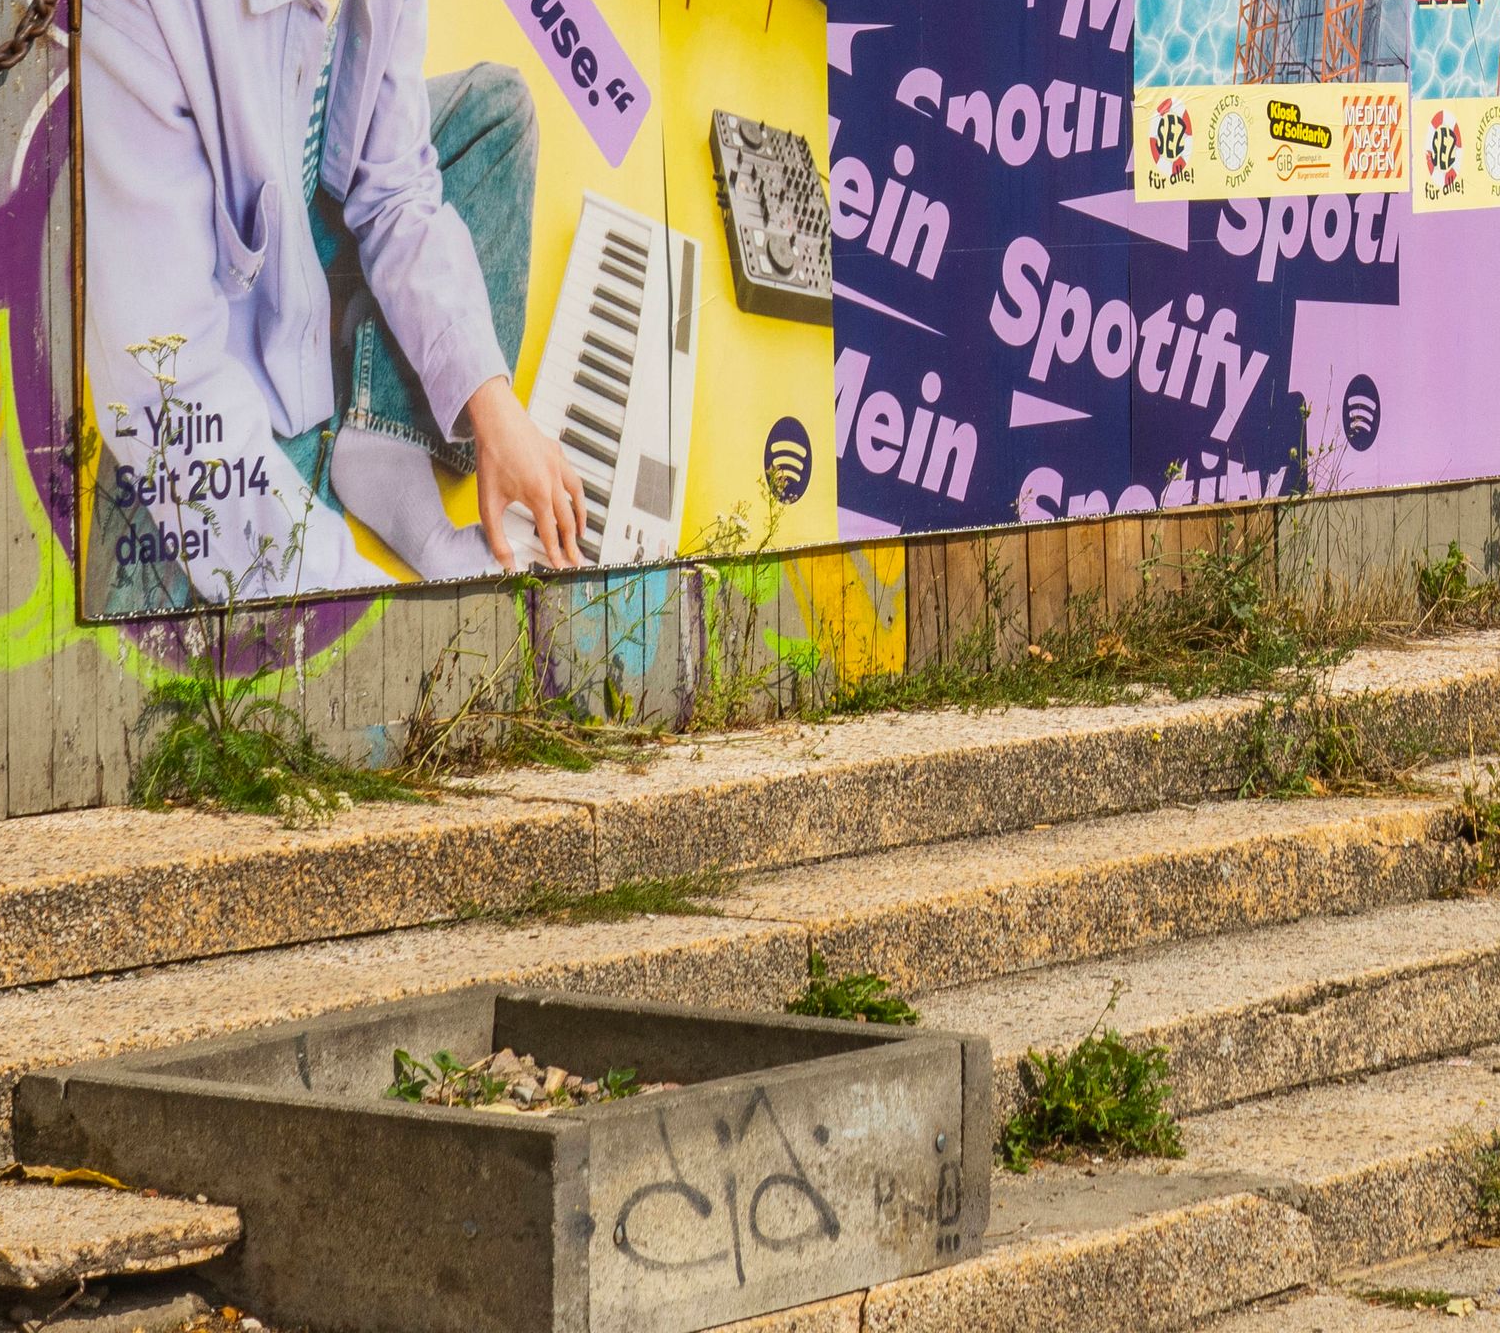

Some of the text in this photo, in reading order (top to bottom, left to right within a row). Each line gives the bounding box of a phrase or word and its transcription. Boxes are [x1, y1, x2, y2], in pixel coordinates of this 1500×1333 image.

[1270, 102, 1298, 122] Kiosk
[1344, 105, 1399, 126] MEDIZIN
[1157, 114, 1187, 159] SEZ
[1210, 94, 1240, 161] ARCHITECTS
[1272, 122, 1330, 146] of Solidarity
[1353, 128, 1391, 149] NACH
[1225, 158, 1254, 188] FUTURE
[1348, 150, 1395, 173] NOTEN
[1149, 167, 1195, 190] für alle!
[989, 235, 1271, 442] Spotify
[144, 402, 223, 456] Yujin
[115, 456, 270, 508] Seit 2014
[115, 517, 210, 566] dabei
